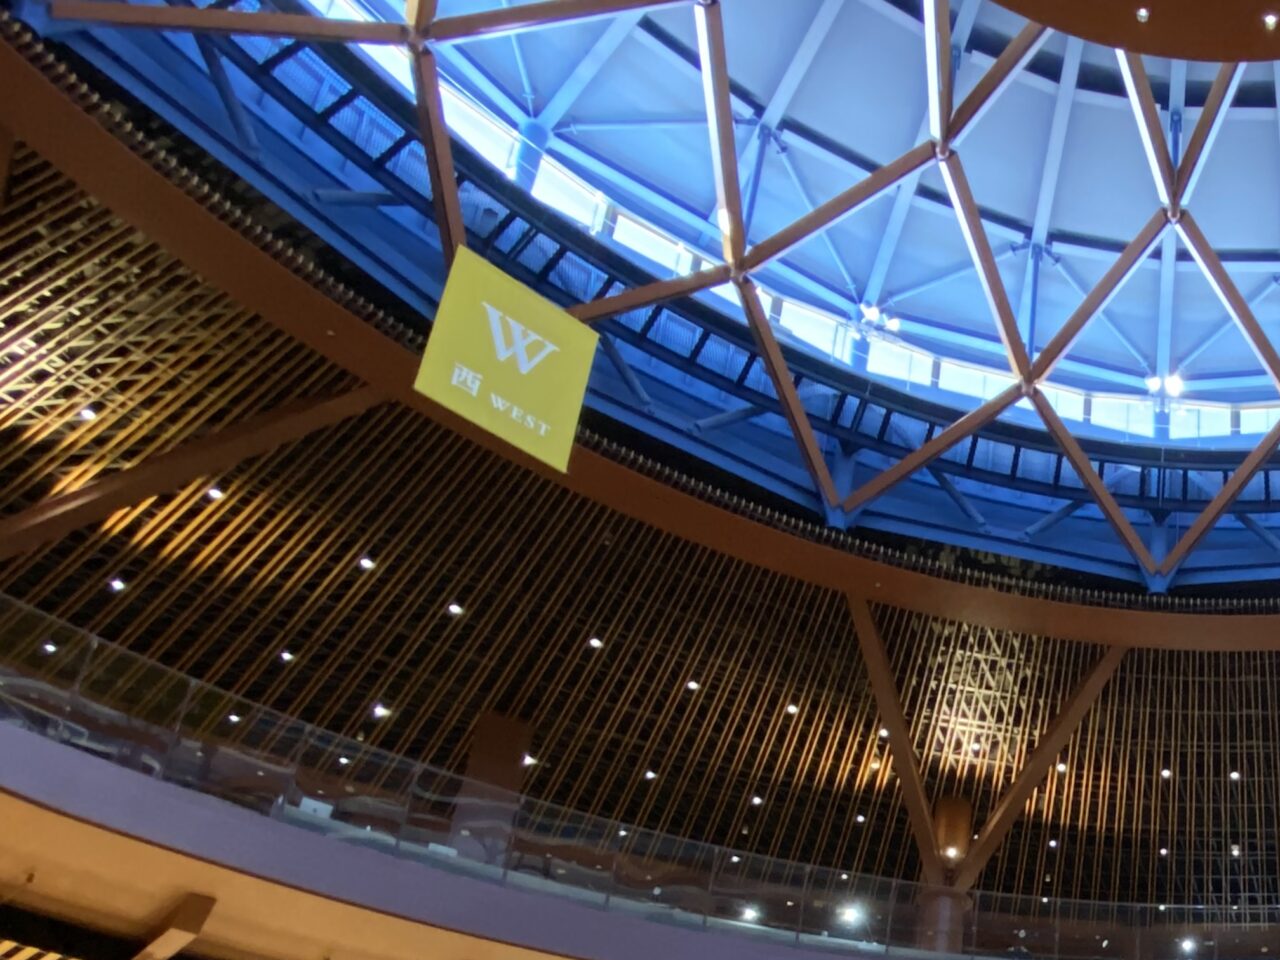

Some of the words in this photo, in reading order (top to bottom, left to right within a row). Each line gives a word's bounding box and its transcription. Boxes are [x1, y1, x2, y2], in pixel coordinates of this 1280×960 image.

[481, 301, 560, 376] W
[450, 362, 483, 398] 西
[490, 391, 551, 437] WEST
